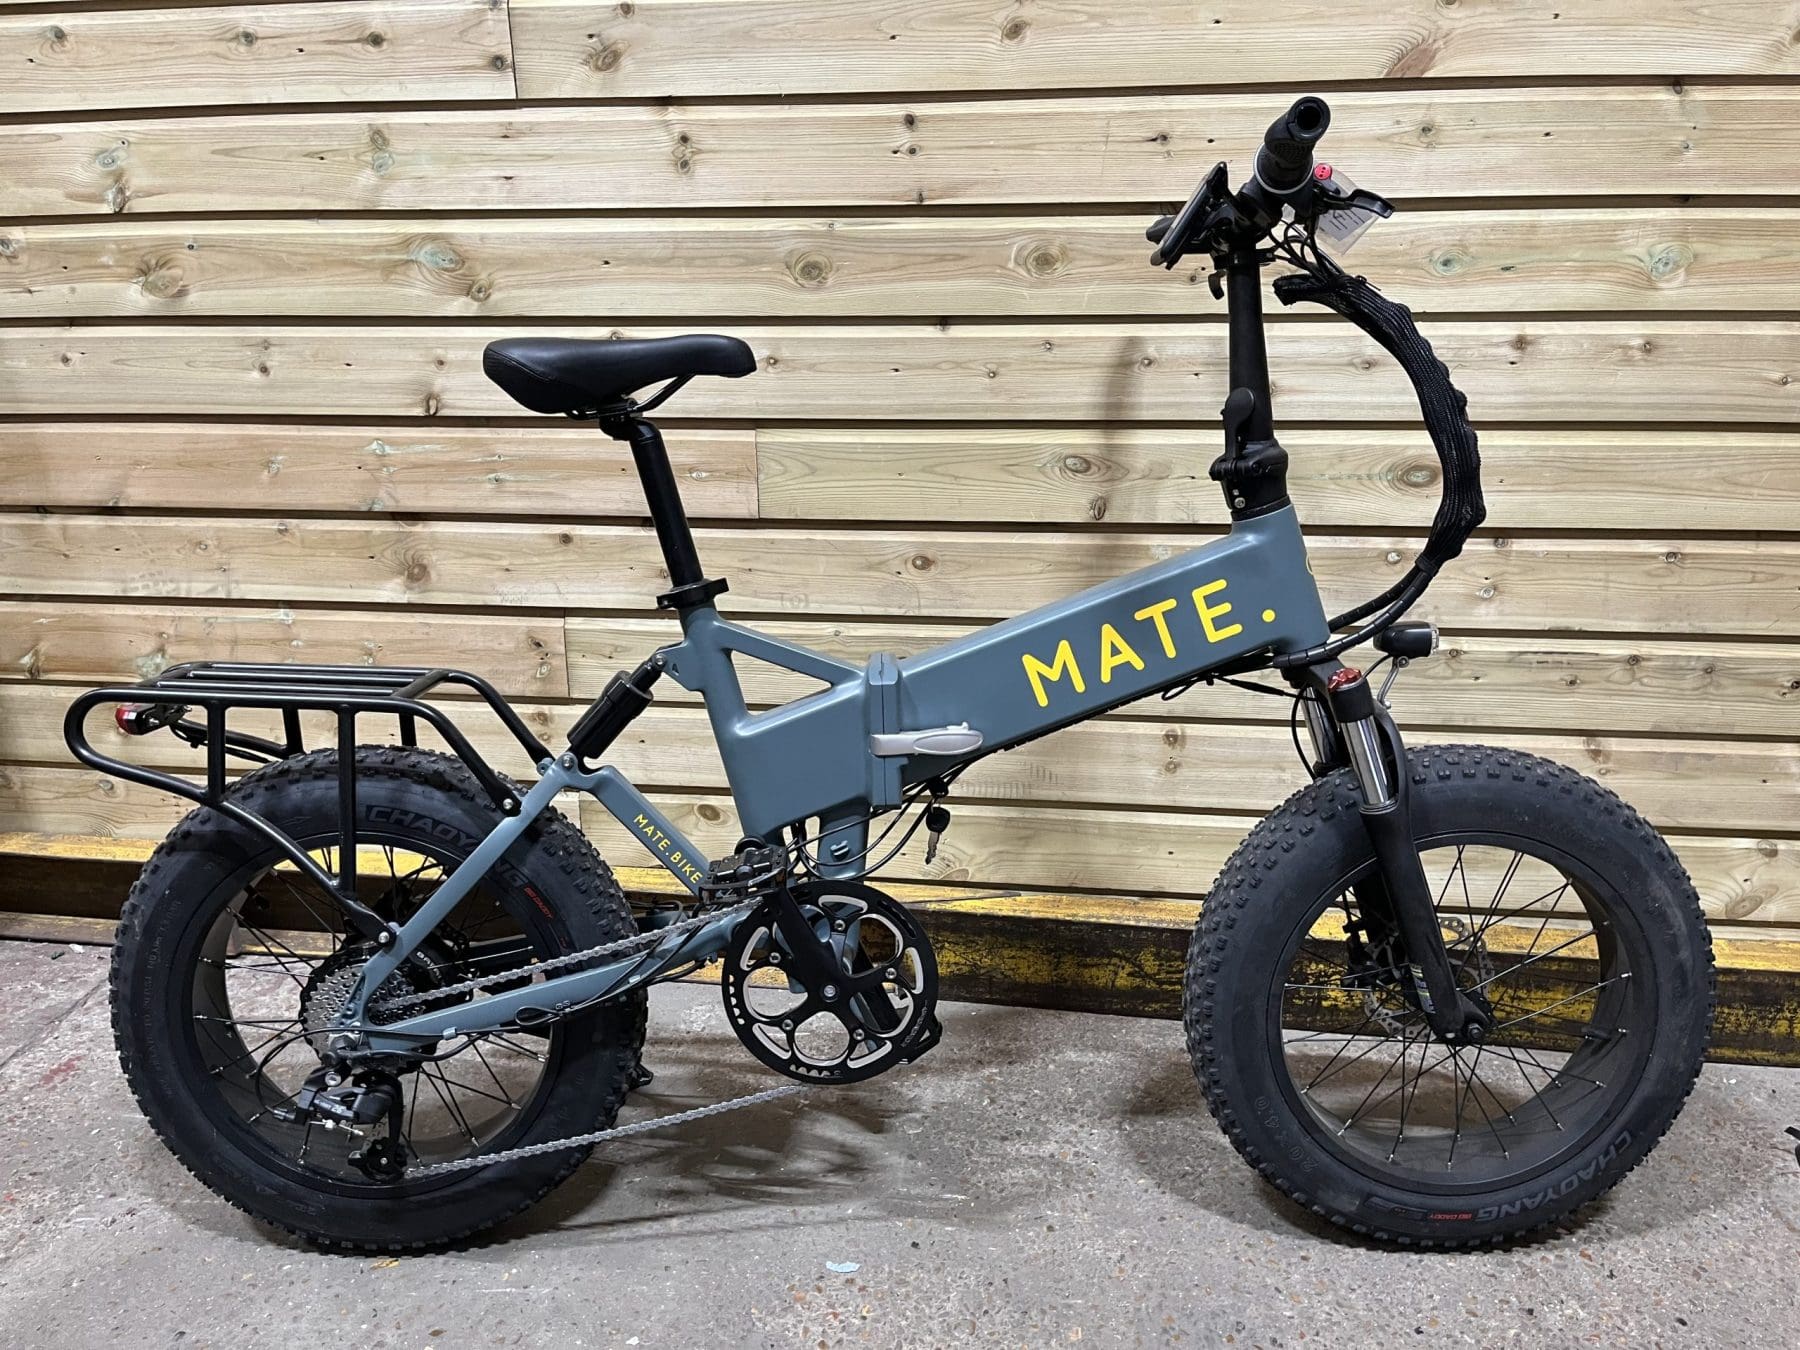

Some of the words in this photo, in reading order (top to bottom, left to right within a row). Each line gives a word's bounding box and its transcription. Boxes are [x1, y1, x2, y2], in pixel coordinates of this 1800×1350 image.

[1022, 578, 1276, 707] MATE.
[633, 814, 703, 884] MATE.BIKE
[1474, 1130, 1632, 1222] CHAOYANG
